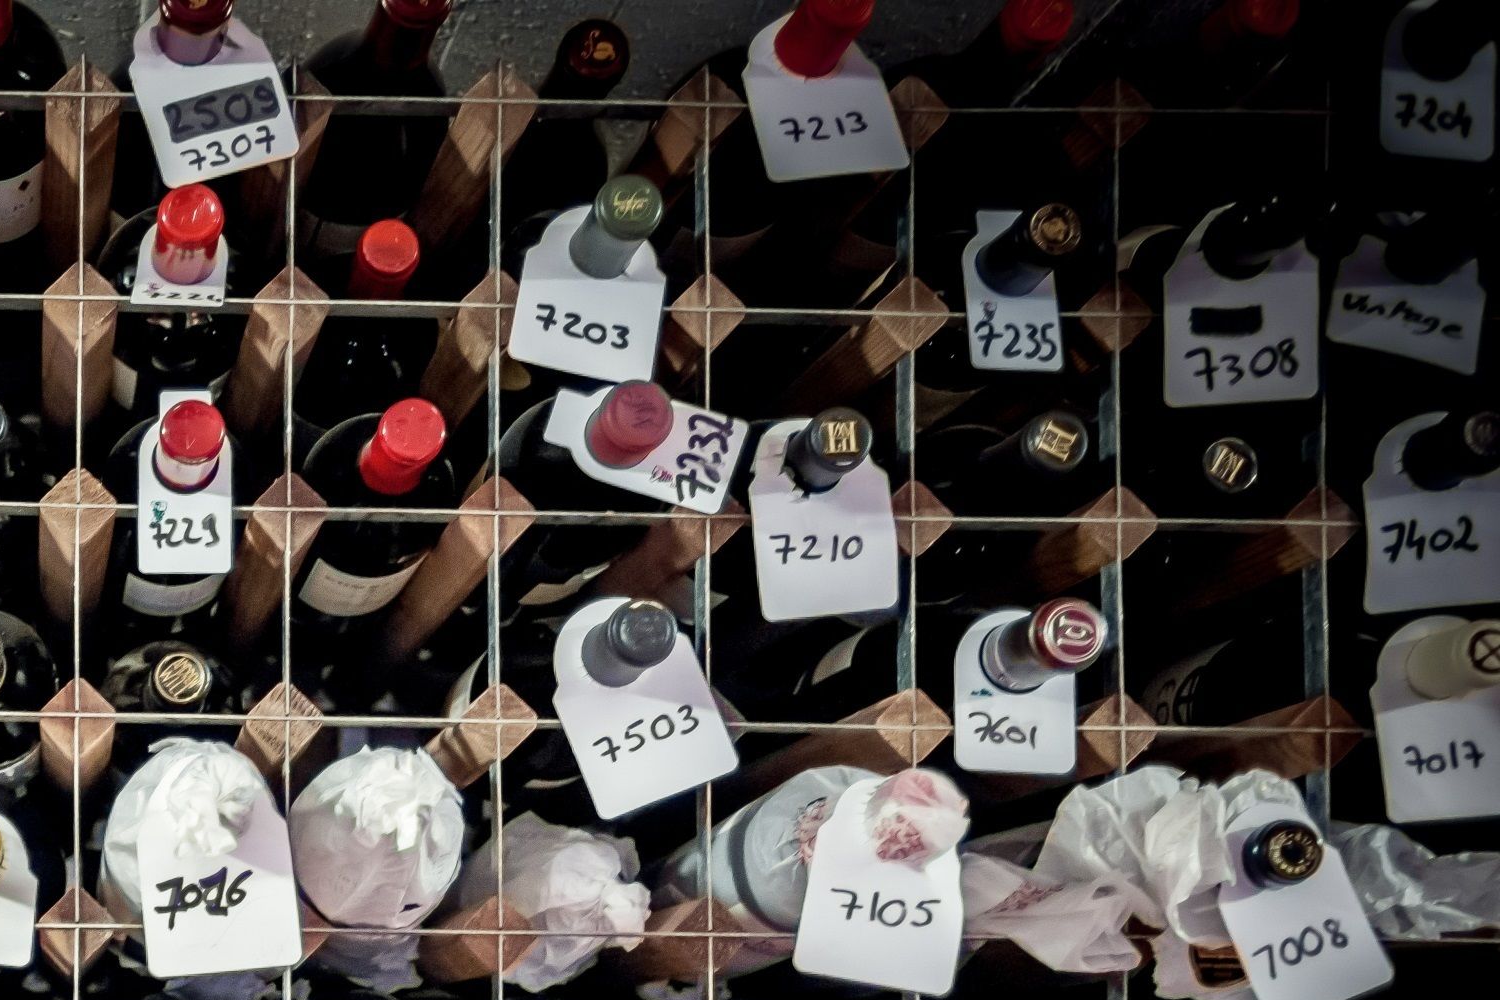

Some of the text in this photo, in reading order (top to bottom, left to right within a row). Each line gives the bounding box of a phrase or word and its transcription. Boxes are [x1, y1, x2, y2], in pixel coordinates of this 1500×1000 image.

[780, 112, 868, 142] 7213
[1396, 94, 1472, 138] 7204
[181, 125, 276, 170] 7307
[536, 304, 629, 350] 7203
[974, 322, 1057, 361] 7235
[1186, 346, 1299, 390] 7308
[151, 517, 219, 549] 7229
[769, 535, 863, 563] 7210
[1382, 516, 1478, 562] 7402
[593, 704, 699, 762] 7503
[969, 712, 1036, 749] 7601
[1404, 740, 1484, 775] 7017
[831, 888, 941, 926] 7105
[1252, 919, 1349, 979] 7008
